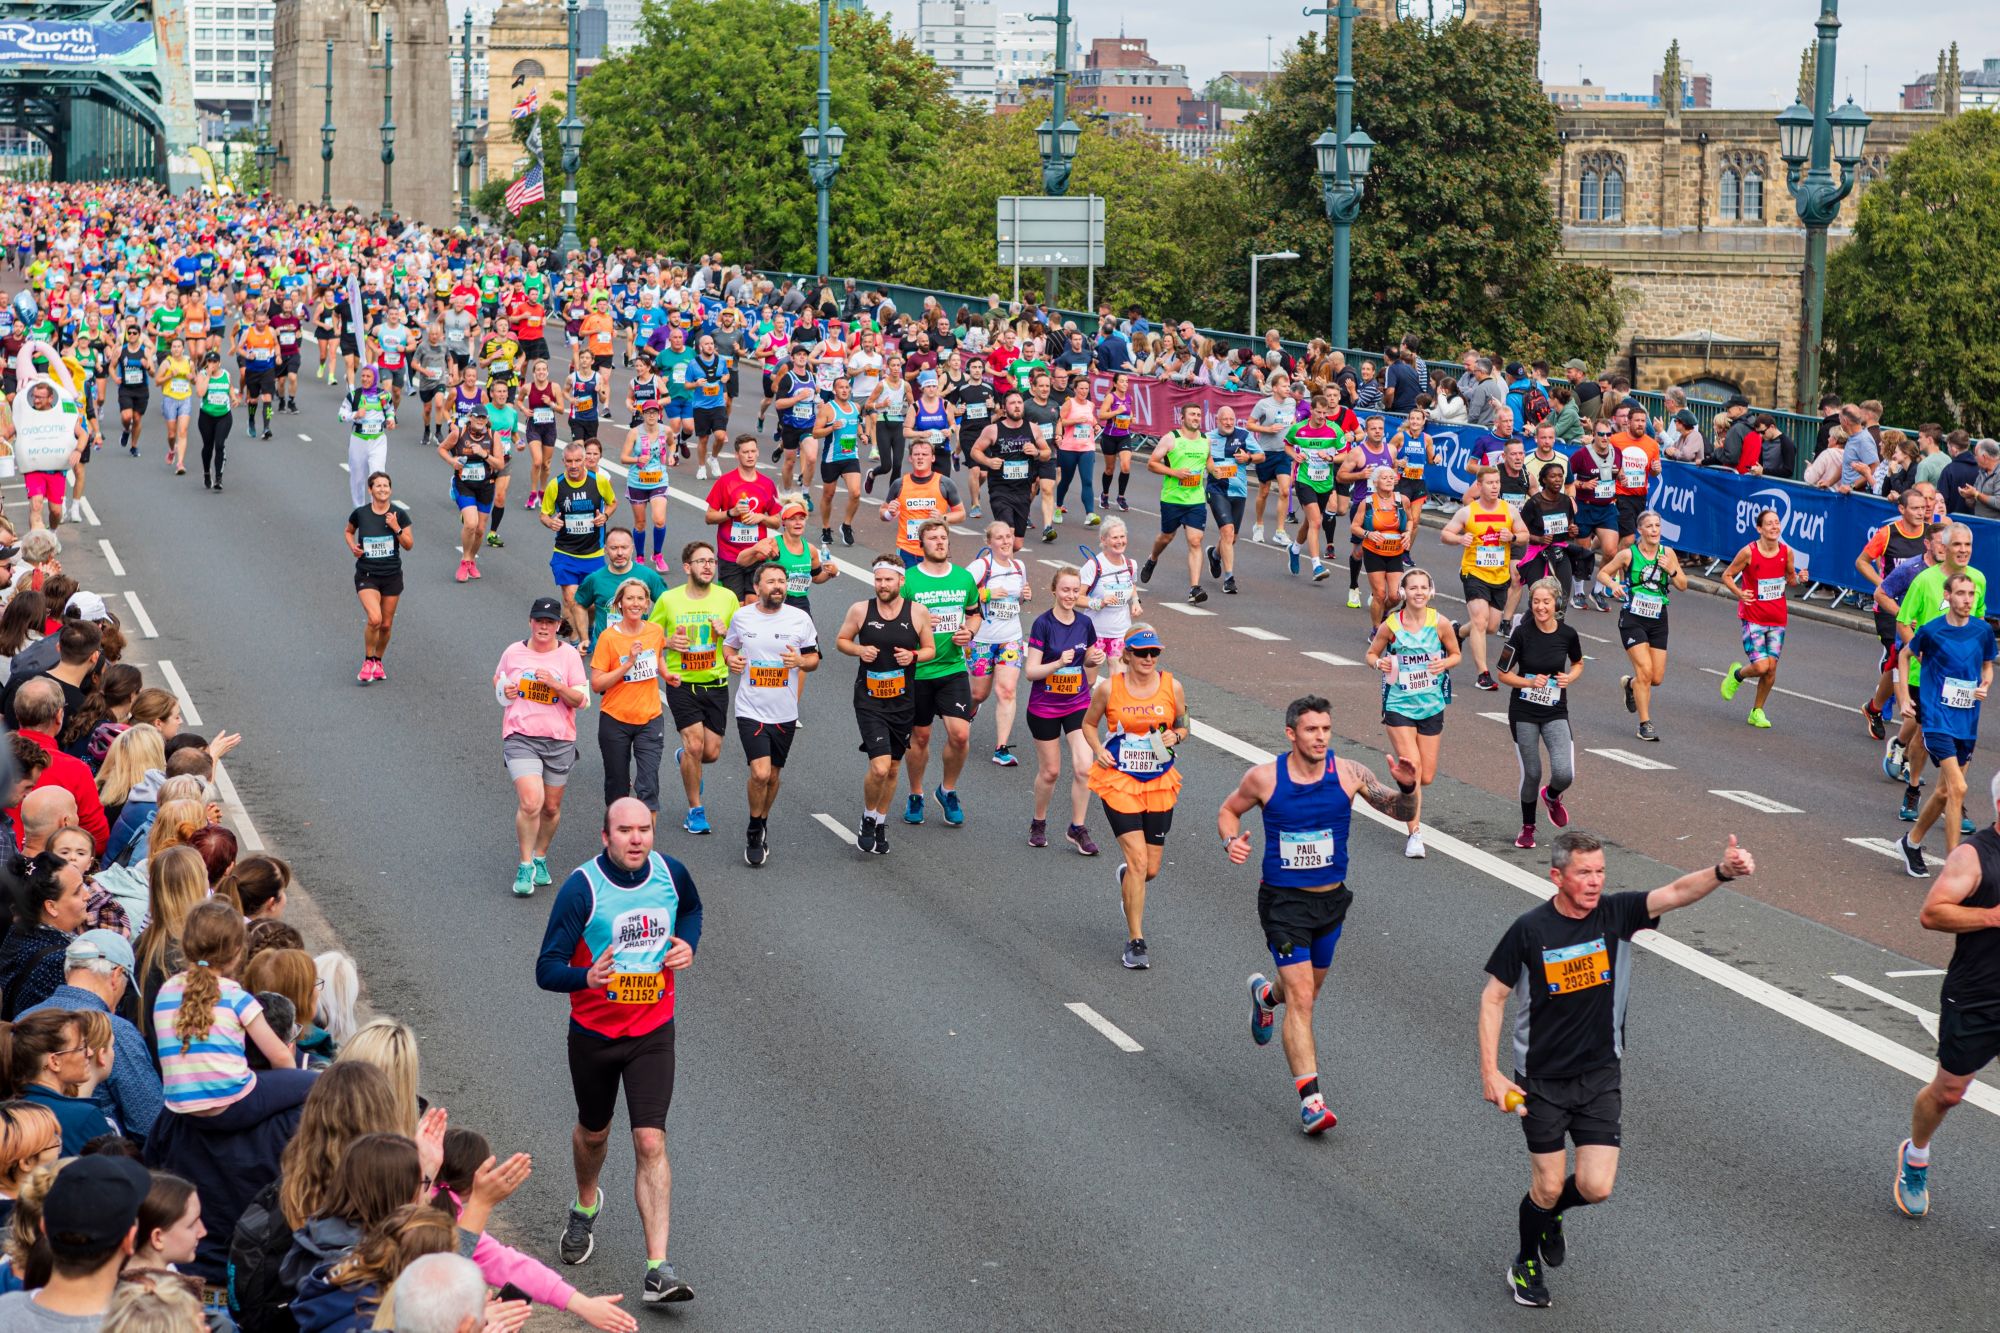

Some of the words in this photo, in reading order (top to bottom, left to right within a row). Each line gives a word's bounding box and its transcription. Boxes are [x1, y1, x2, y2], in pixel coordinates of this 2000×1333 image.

[36, 27, 93, 43] north
[62, 43, 97, 54] run
[22, 423, 67, 435] ovacome
[28, 447, 39, 456] Mr
[41, 446, 65, 457] Ovary
[572, 492, 587, 501] IAN
[1662, 485, 1695, 515] run
[907, 499, 936, 507] action
[1790, 510, 1825, 543] run
[371, 542, 386, 550] HAZEL
[1763, 584, 1781, 592] SUZANNE
[915, 590, 967, 601] MACMILLAN
[682, 651, 714, 662] ALEXANDER
[1403, 654, 1430, 665] EMMA
[634, 660, 649, 671] KATY
[756, 669, 783, 678] ANDREW
[1052, 674, 1077, 684] ELEANOR
[1409, 671, 1428, 681] EMMA
[528, 681, 551, 693] LOUISE
[759, 677, 780, 687] 17202
[1056, 684, 1072, 692] 4240
[1956, 688, 1969, 698] PHIL
[1529, 692, 1550, 704] 25442
[1122, 703, 1164, 716] mnda
[1130, 761, 1154, 771] 21867
[1297, 843, 1318, 855] PAUL
[1294, 854, 1322, 867] 27329
[628, 914, 641, 923] THE
[624, 938, 657, 950] CHARITY
[1562, 956, 1595, 977] JAMES
[620, 974, 658, 988] PATRICK
[1564, 971, 1597, 991] 29236
[622, 988, 655, 1001] 21152
